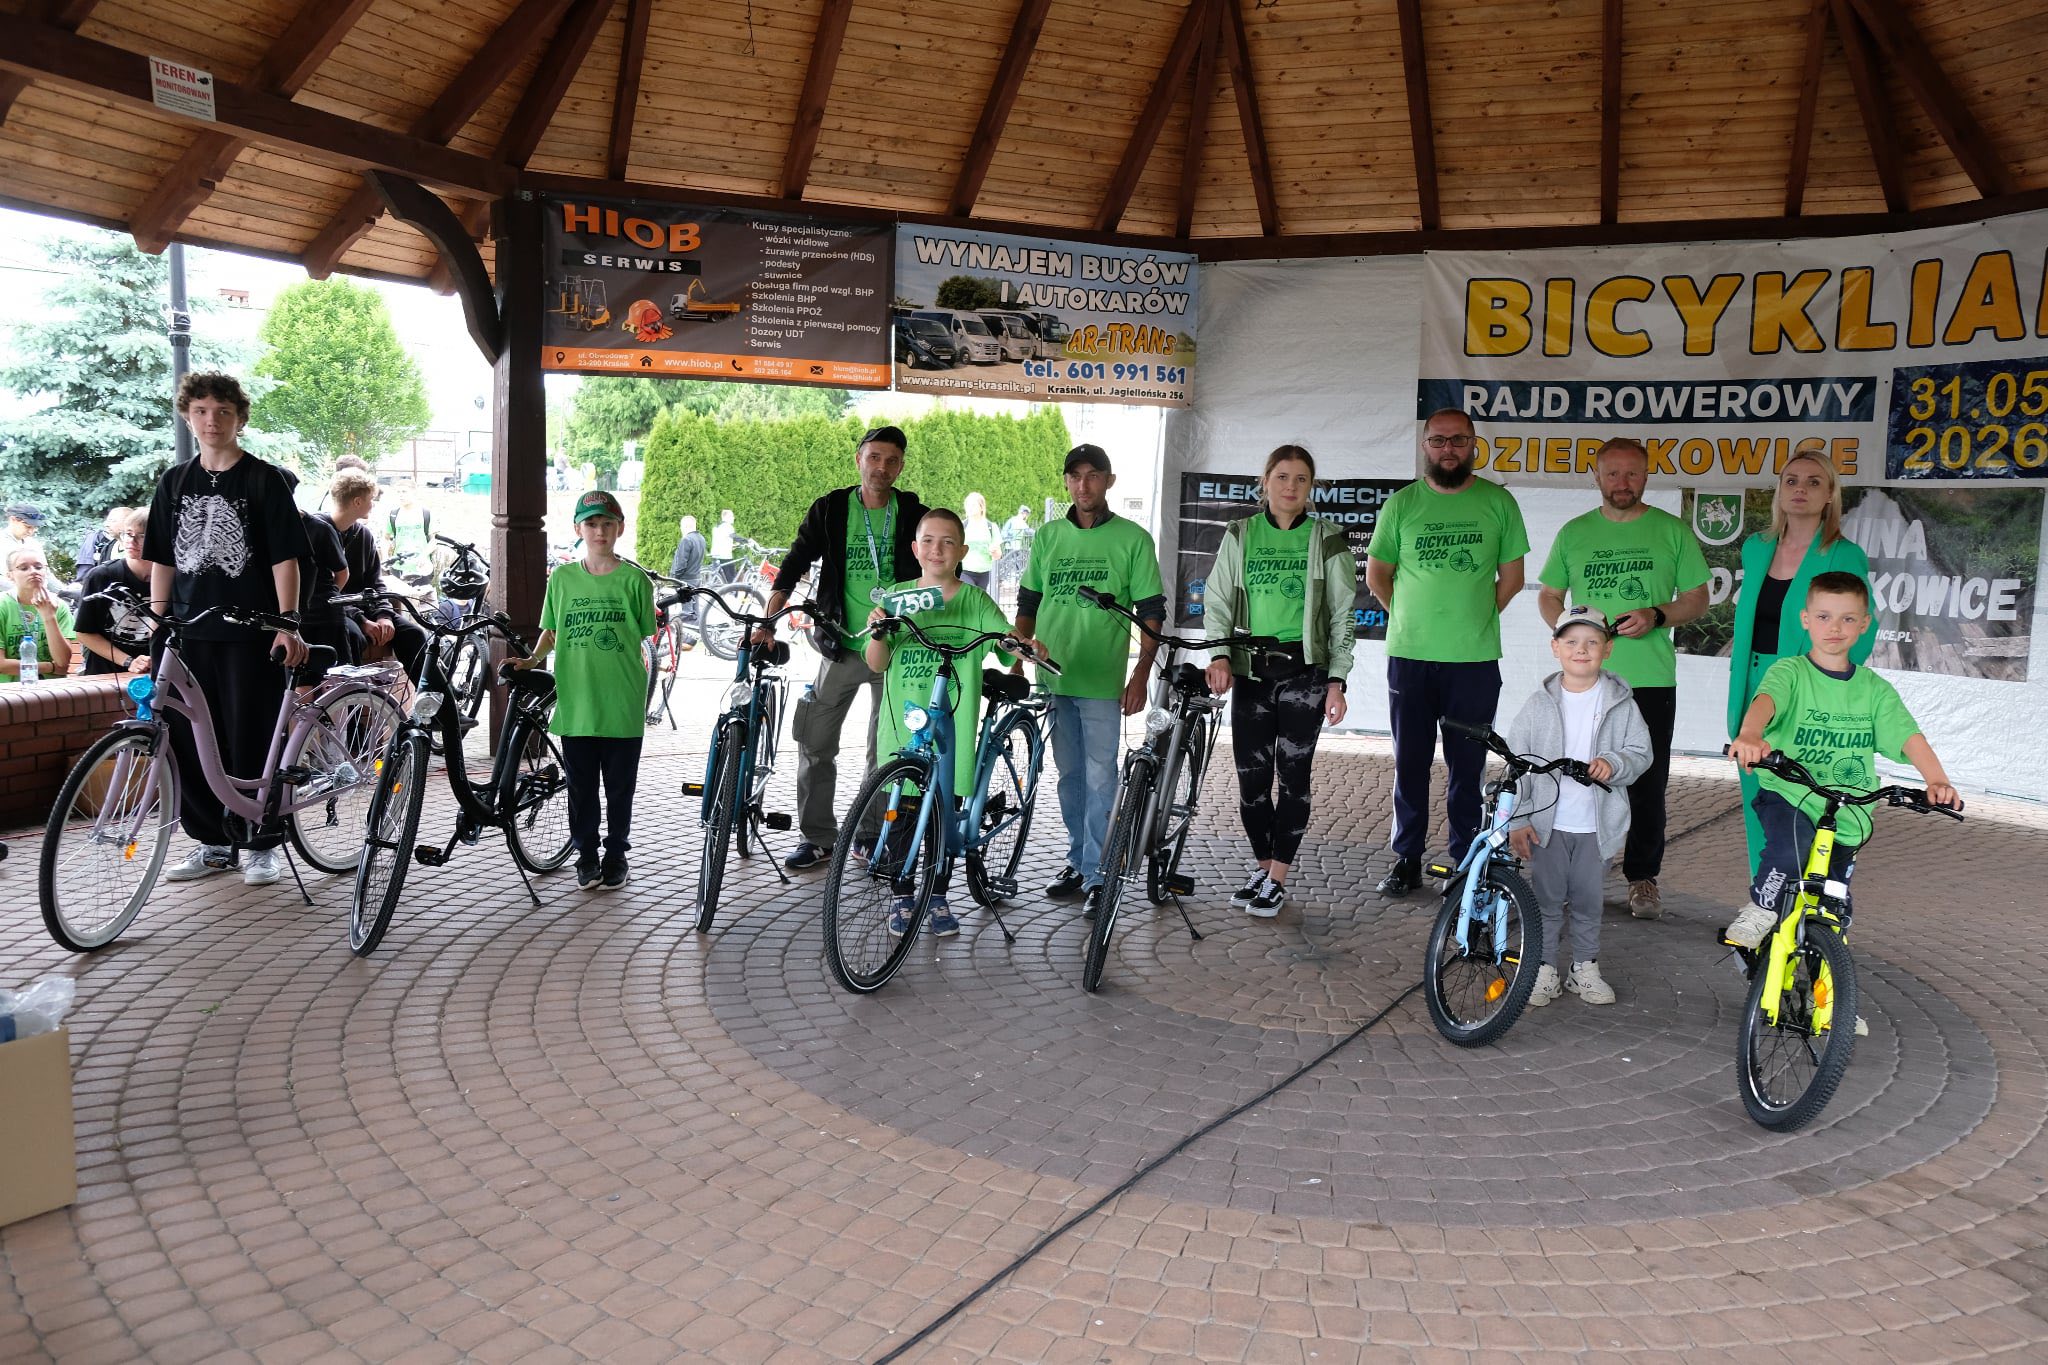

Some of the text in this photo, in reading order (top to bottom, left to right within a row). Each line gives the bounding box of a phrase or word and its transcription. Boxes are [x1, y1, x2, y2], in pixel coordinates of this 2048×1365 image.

[154, 61, 197, 84] TEREN
[156, 78, 211, 101] MONITOROWANY
[563, 203, 701, 252] HIOB
[752, 221, 852, 238] Kursy specjalistyczne:
[765, 235, 791, 245] wózki
[583, 254, 682, 272] SERWIS
[765, 246, 800, 257] żurawie
[850, 252, 875, 263] (HDS)
[914, 236, 1189, 286] WYNAJEM BUSÓW
[765, 260, 800, 270] podesty
[751, 281, 874, 297] Obsługa firm pod wzgl. BHP
[751, 292, 817, 304] Szkolenia BHP
[1000, 281, 1189, 315] I AUTOKARÓW
[1464, 247, 2048, 358] BICYKLIA
[751, 302, 795, 314] Szkolenia
[751, 314, 795, 326] Szkolenia
[803, 320, 845, 331] pierwszej
[846, 323, 881, 334] pomocy
[751, 327, 805, 338] Dozory UDT
[750, 338, 782, 348] Serwis
[664, 358, 724, 370] www.hiob.pl
[1023, 360, 1186, 386] tel. 601 991 561
[901, 375, 1036, 394] www.artrans-krasnik.pl
[1047, 384, 1185, 400] Kraśnik, ul. Jagiellońska 256
[1463, 382, 1864, 418] RAJD ROWEROWY
[1909, 370, 2048, 421] 31.05
[1903, 423, 2048, 470] 2026
[1415, 533, 1483, 550] BICYKLIADA
[1418, 548, 1449, 561] 2026
[1247, 559, 1308, 574] BICYKLIAD
[1583, 560, 1654, 578] BICYKLIADA
[1049, 570, 1109, 586] BICYKLIADA
[1249, 572, 1279, 586] 2026
[1587, 576, 1618, 590] 2026
[891, 591, 934, 617] 750
[565, 610, 627, 628] BICYKLIADA
[567, 625, 594, 640] 2026
[902, 665, 933, 679] 2026
[1795, 748, 1836, 765] 2026
